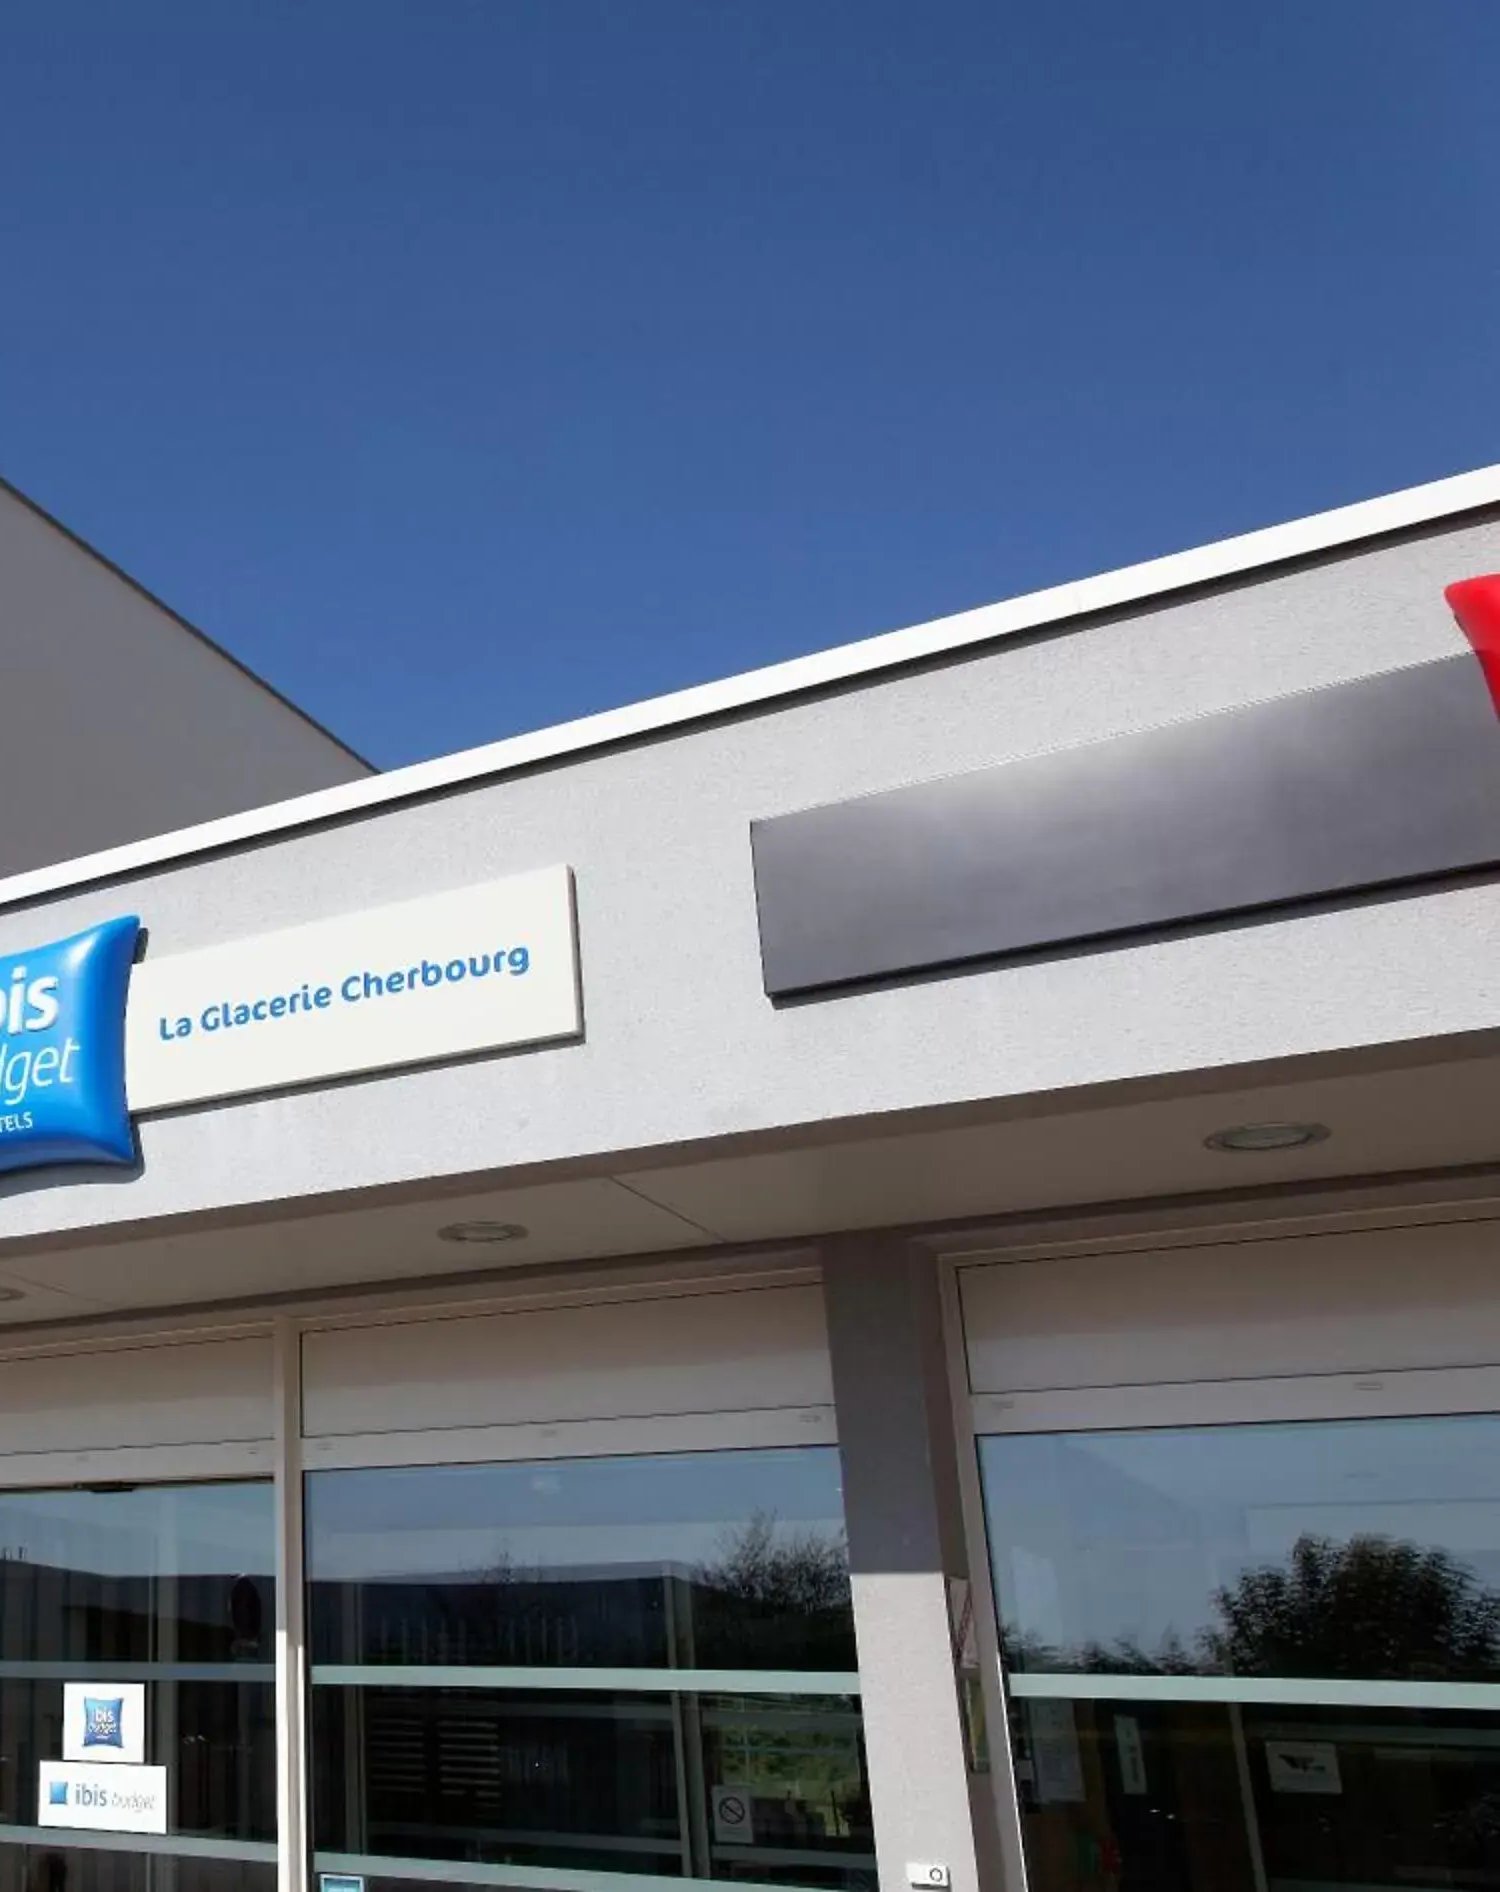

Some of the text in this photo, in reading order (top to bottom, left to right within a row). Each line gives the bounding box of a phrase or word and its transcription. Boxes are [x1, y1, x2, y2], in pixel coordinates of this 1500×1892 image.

[159, 945, 530, 1041] La Glacerie Cherbourg
[75, 1783, 108, 1807] ibis
